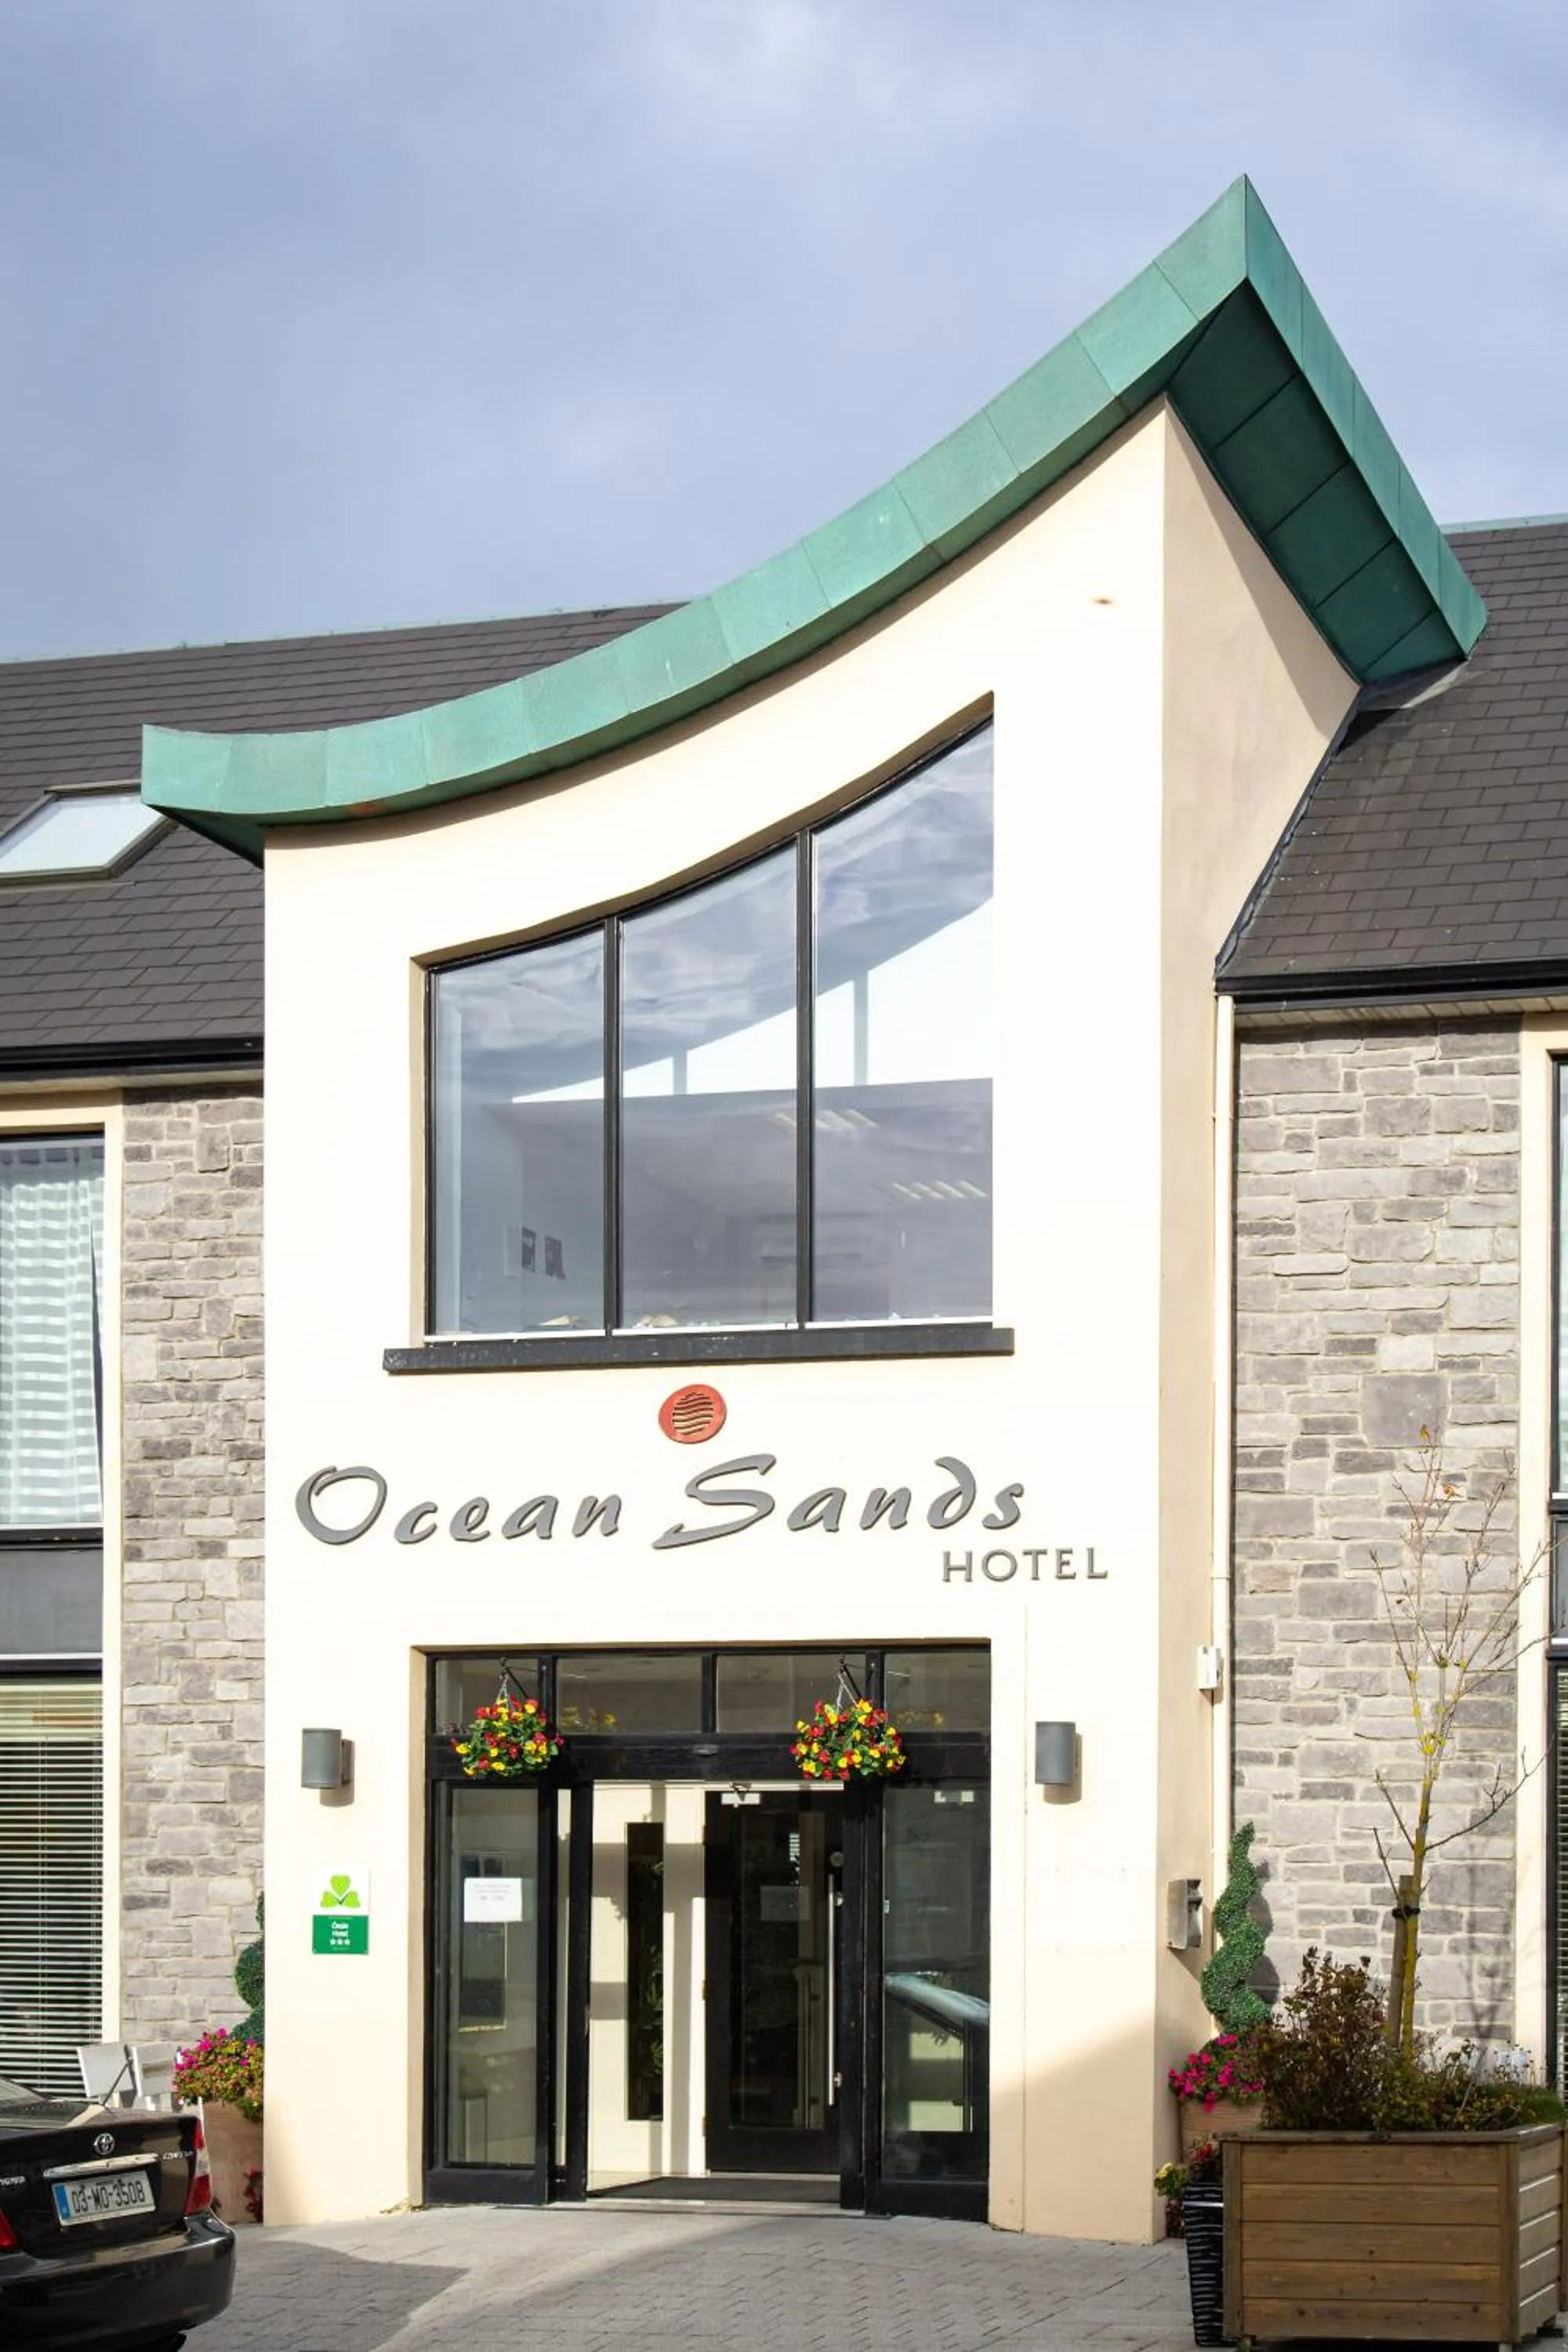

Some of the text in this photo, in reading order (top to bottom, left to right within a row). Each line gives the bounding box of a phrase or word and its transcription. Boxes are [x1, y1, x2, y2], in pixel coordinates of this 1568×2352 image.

[295, 1454, 1025, 1550] Ocean Sands
[942, 1547, 1107, 1582] HOTEL
[71, 2180, 146, 2212] 03-MO-3508
